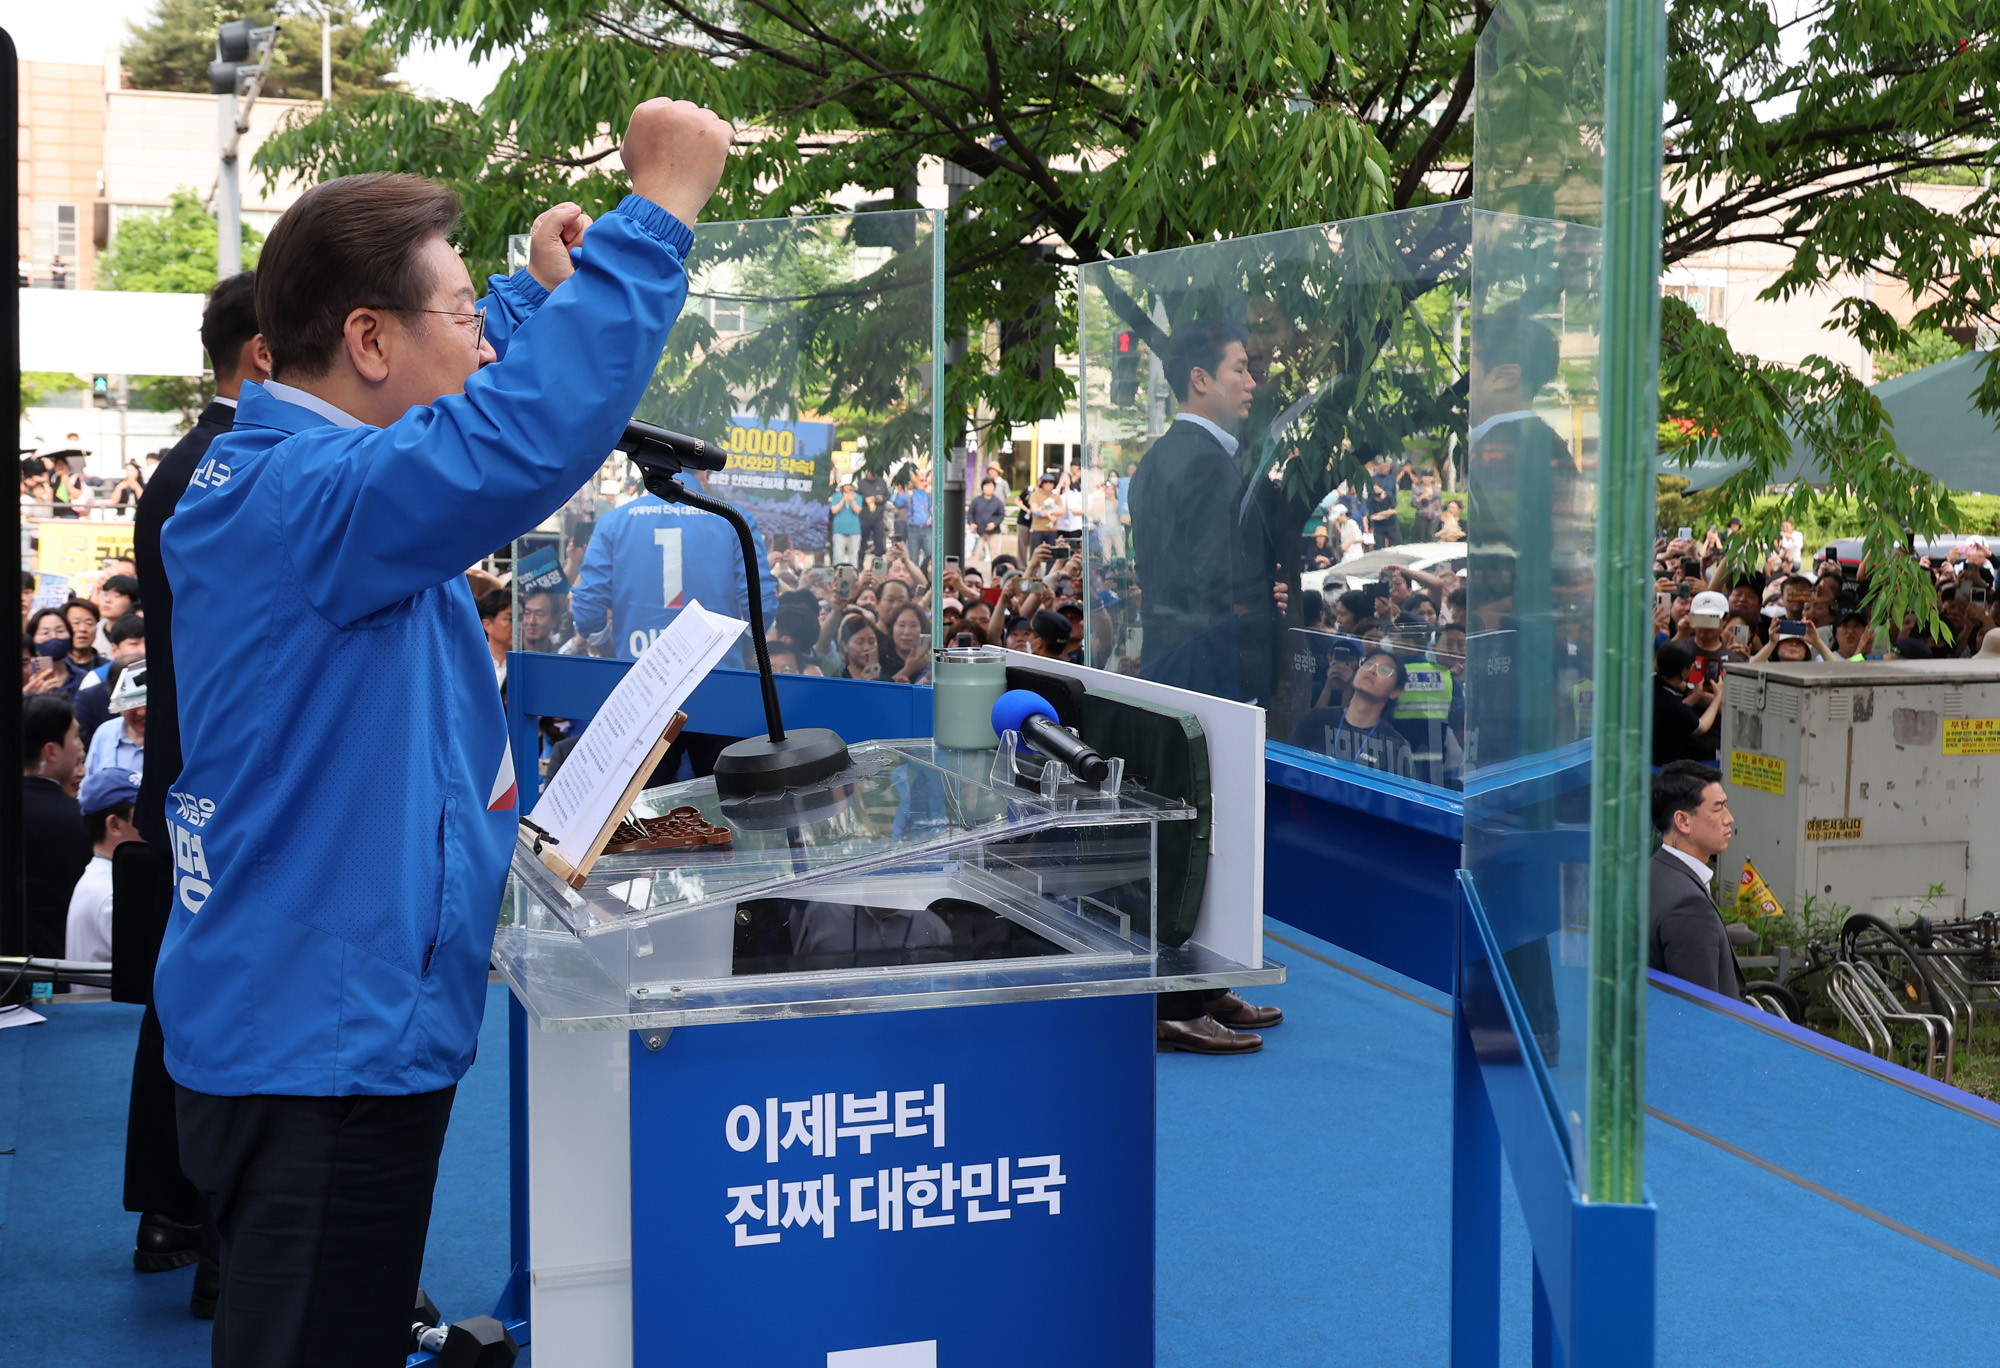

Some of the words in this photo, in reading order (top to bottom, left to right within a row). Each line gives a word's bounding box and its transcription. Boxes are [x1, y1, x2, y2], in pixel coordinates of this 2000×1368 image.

[628, 504, 662, 516] 이제부터
[663, 504, 680, 517] 진짜
[653, 528, 683, 608] 1
[725, 1083, 946, 1163] 이제부터
[725, 1173, 841, 1247] 진짜
[850, 1154, 1067, 1231] 대한민국
